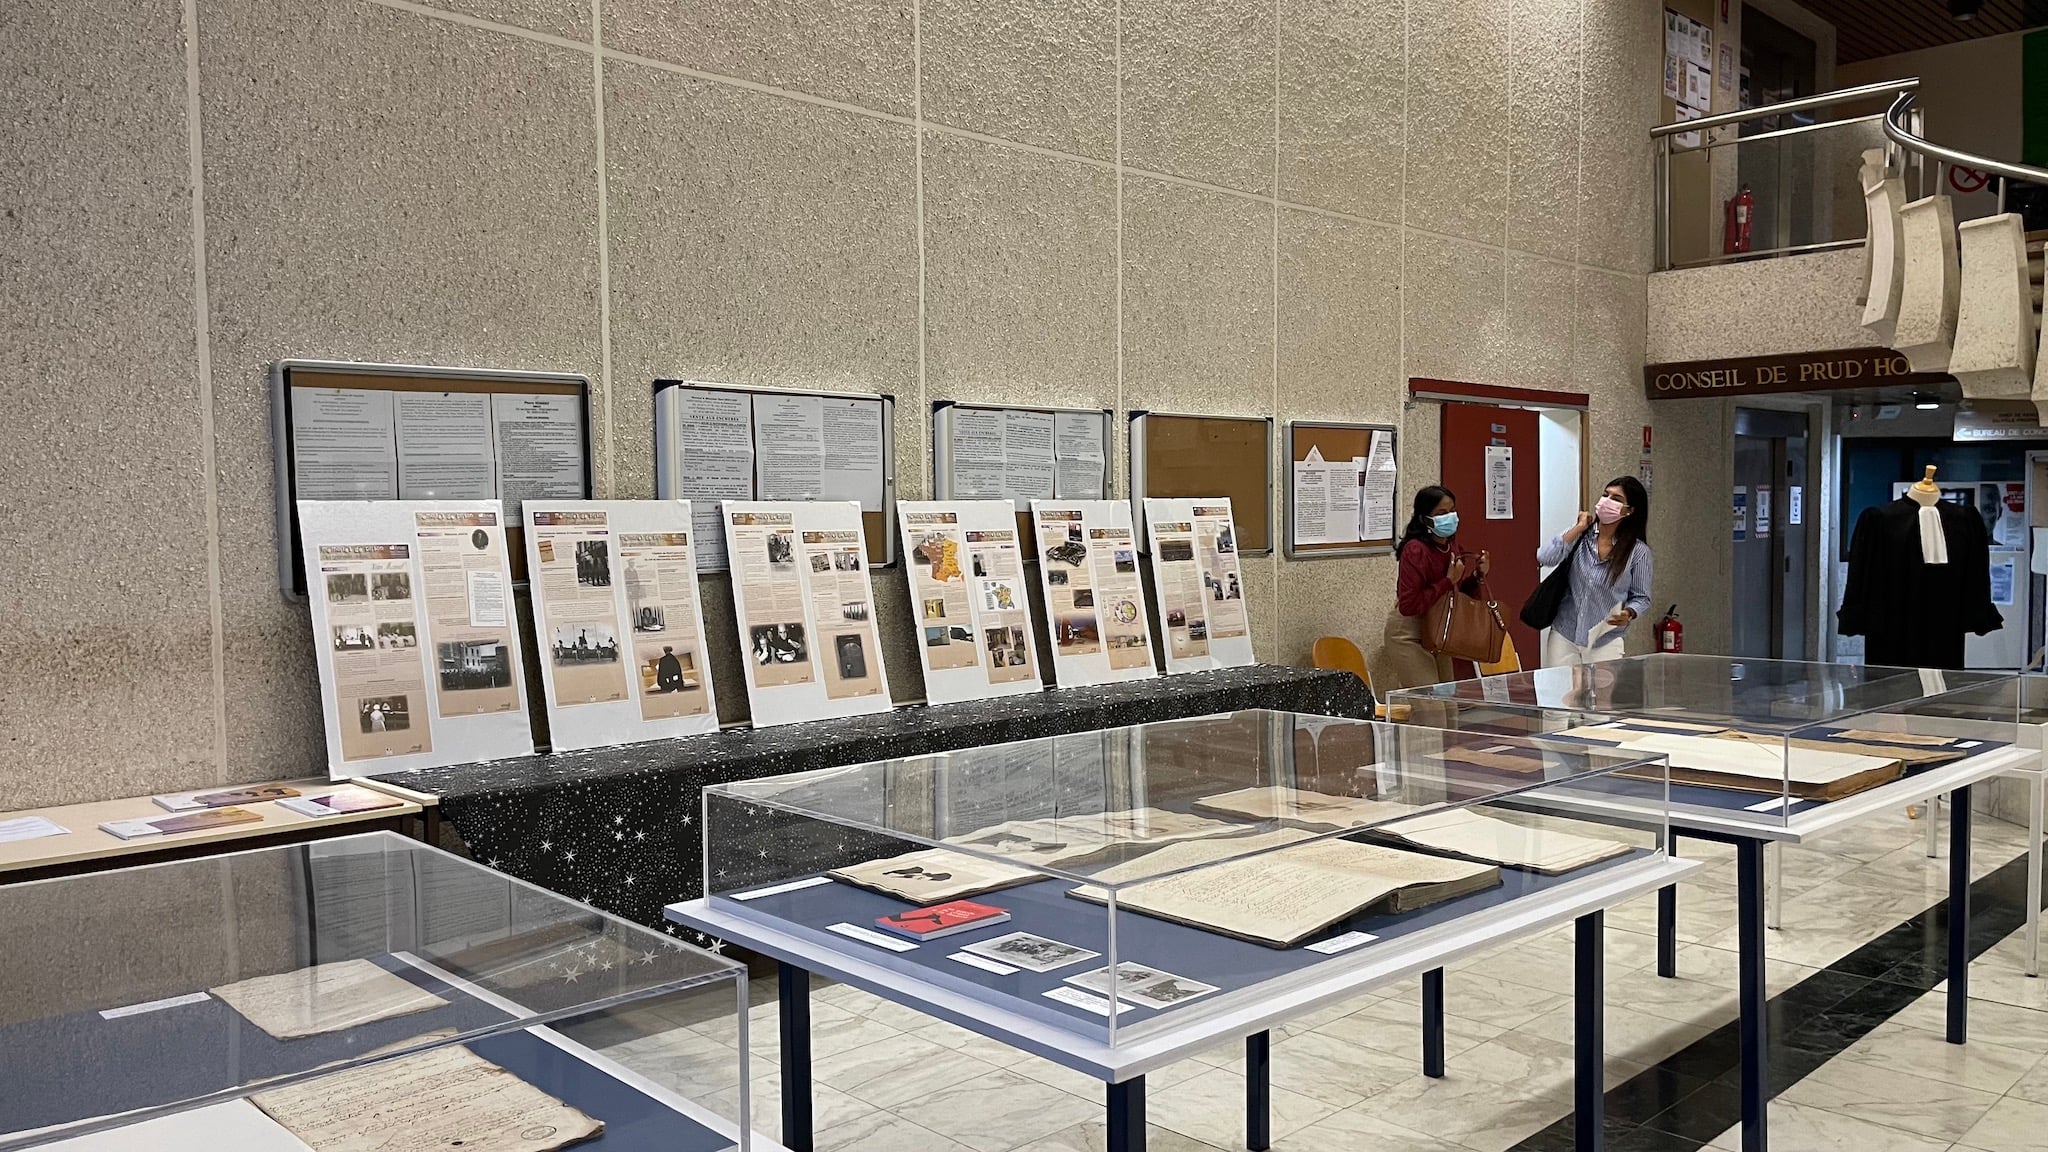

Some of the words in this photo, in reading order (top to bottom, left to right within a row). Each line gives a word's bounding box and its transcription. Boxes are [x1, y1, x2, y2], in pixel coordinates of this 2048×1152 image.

[1655, 368, 1747, 392] CONSEIL
[1756, 365, 1790, 386] DE
[1973, 428, 2006, 437] BUREAU
